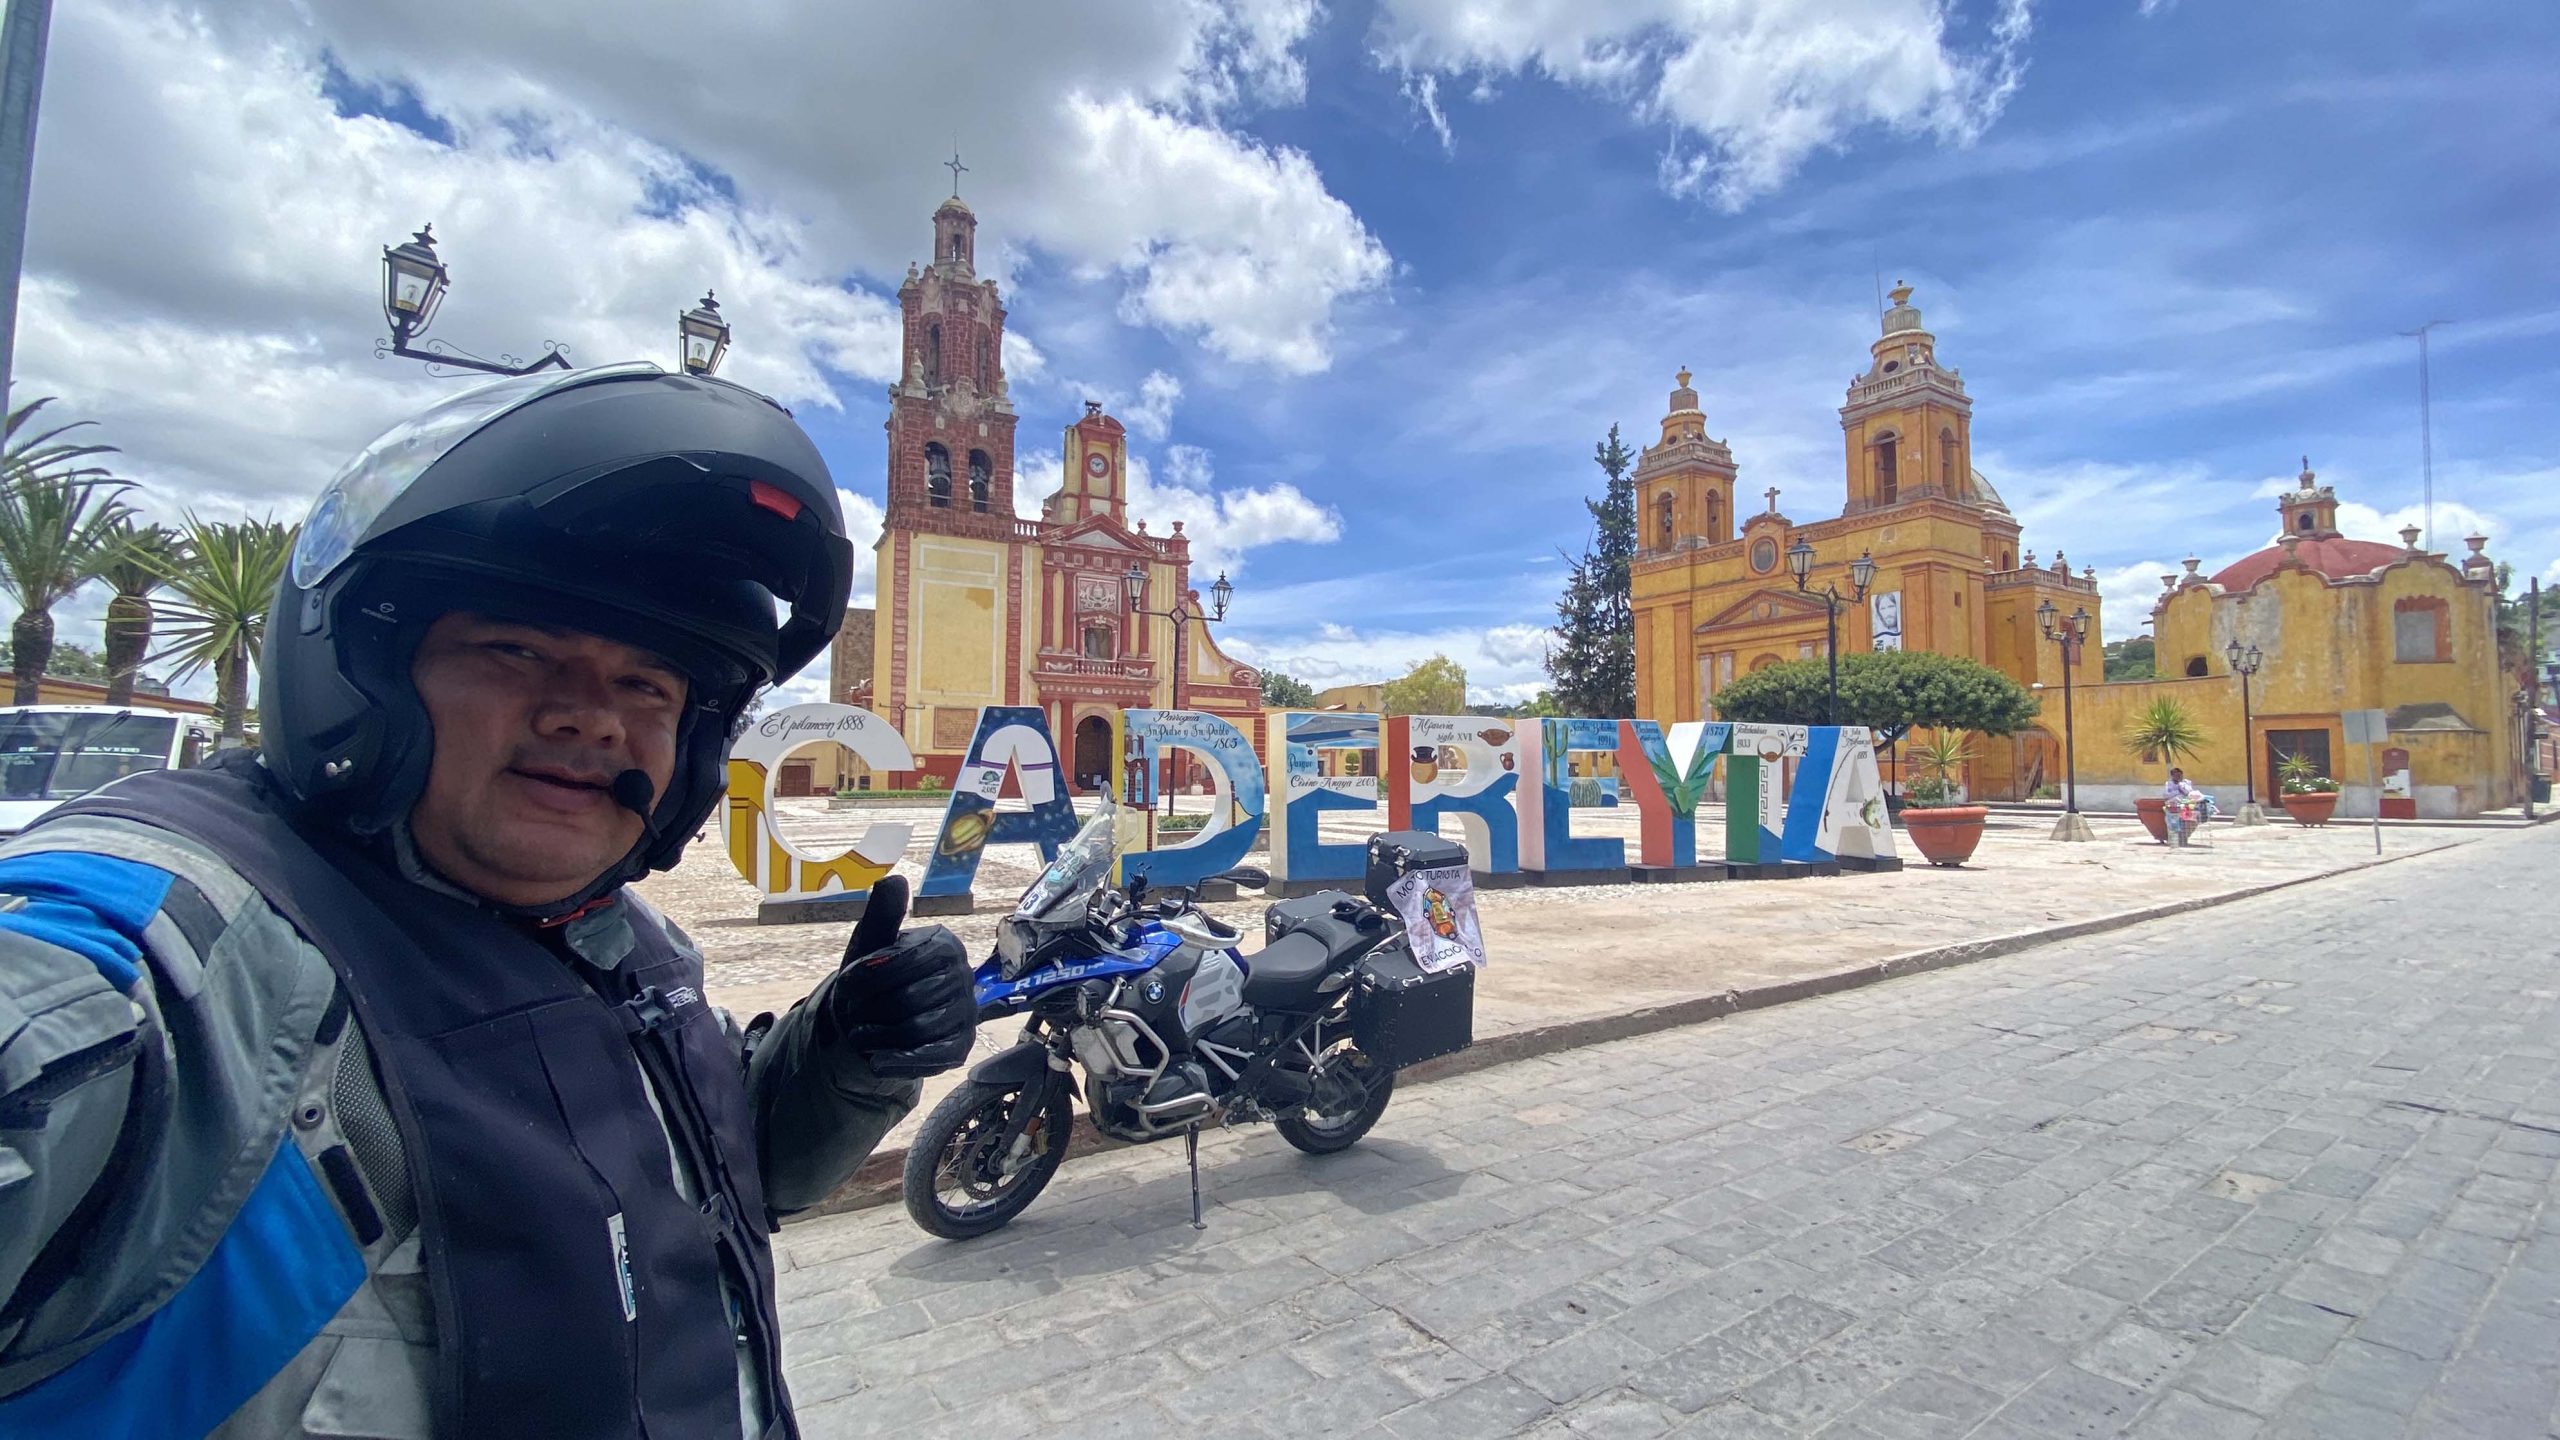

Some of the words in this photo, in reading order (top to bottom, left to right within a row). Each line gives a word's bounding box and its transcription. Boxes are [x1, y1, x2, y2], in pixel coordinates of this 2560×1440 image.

[760, 712, 791, 738] El
[836, 714, 866, 731] 1888
[1203, 722, 1230, 742] Pablo
[1396, 870, 1424, 899] MOTO
[1425, 869, 1461, 880] TURISTA
[1033, 964, 1086, 985] 1250
